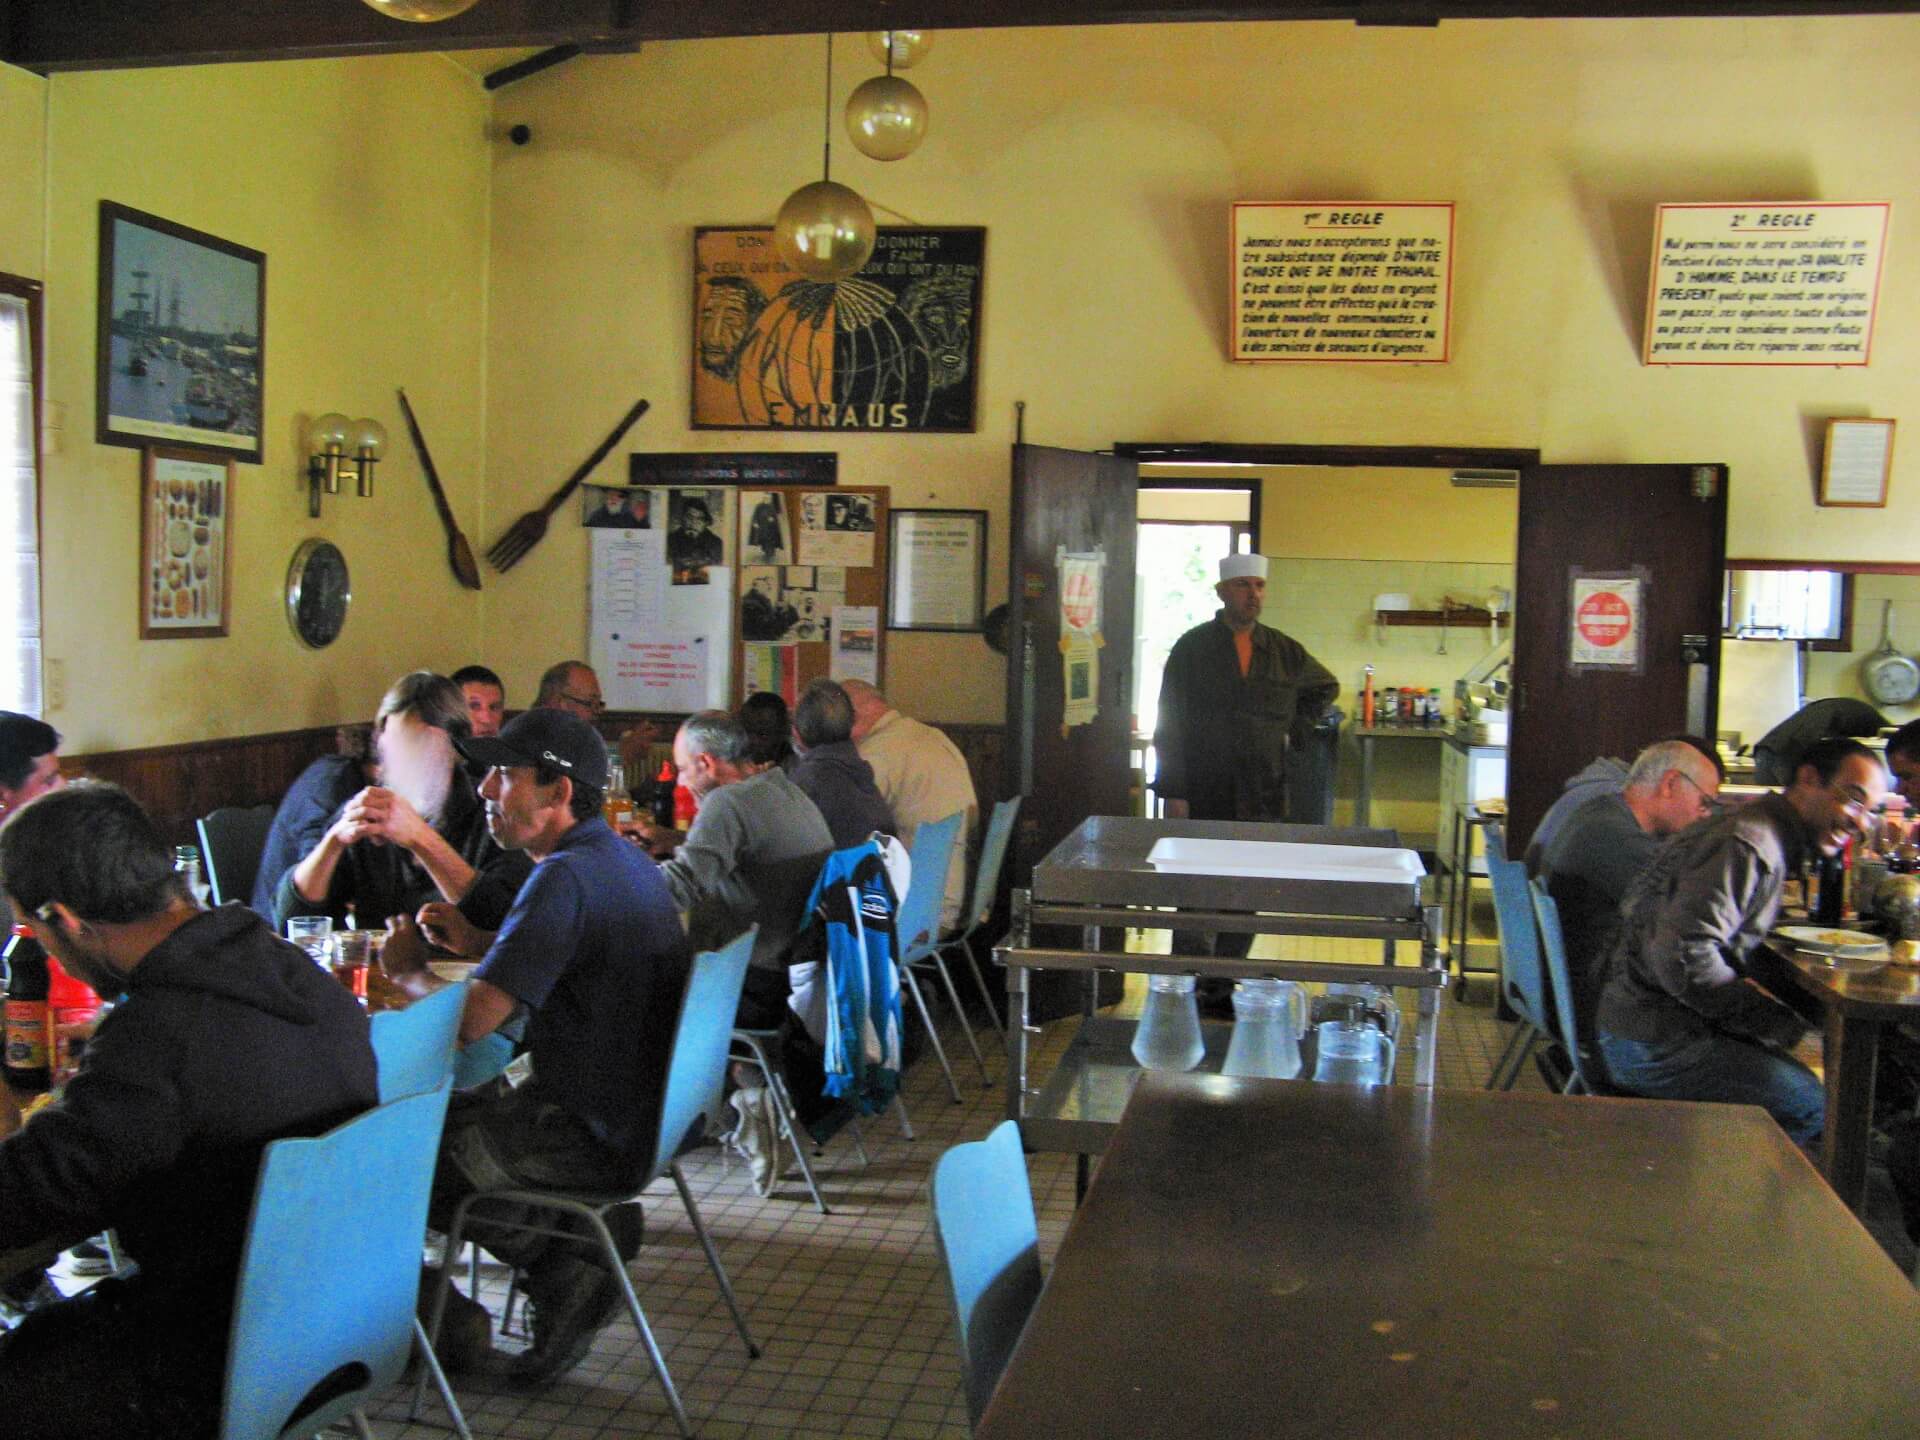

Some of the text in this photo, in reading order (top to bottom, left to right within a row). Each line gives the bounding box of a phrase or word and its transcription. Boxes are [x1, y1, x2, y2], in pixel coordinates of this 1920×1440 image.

[1328, 212, 1384, 225] REGLE
[1758, 213, 1816, 227] REGLE
[878, 236, 941, 249] DONNER
[1264, 251, 1336, 262] subsistance
[1243, 266, 1286, 277] CHOSE
[1289, 266, 1312, 278] QUE
[1316, 266, 1335, 277] DE
[1338, 266, 1379, 277] NOTRE
[1741, 271, 1778, 283] DANS
[1782, 271, 1798, 283] LE
[1801, 271, 1848, 283] TEMPS
[768, 402, 908, 428] EMMAUS
